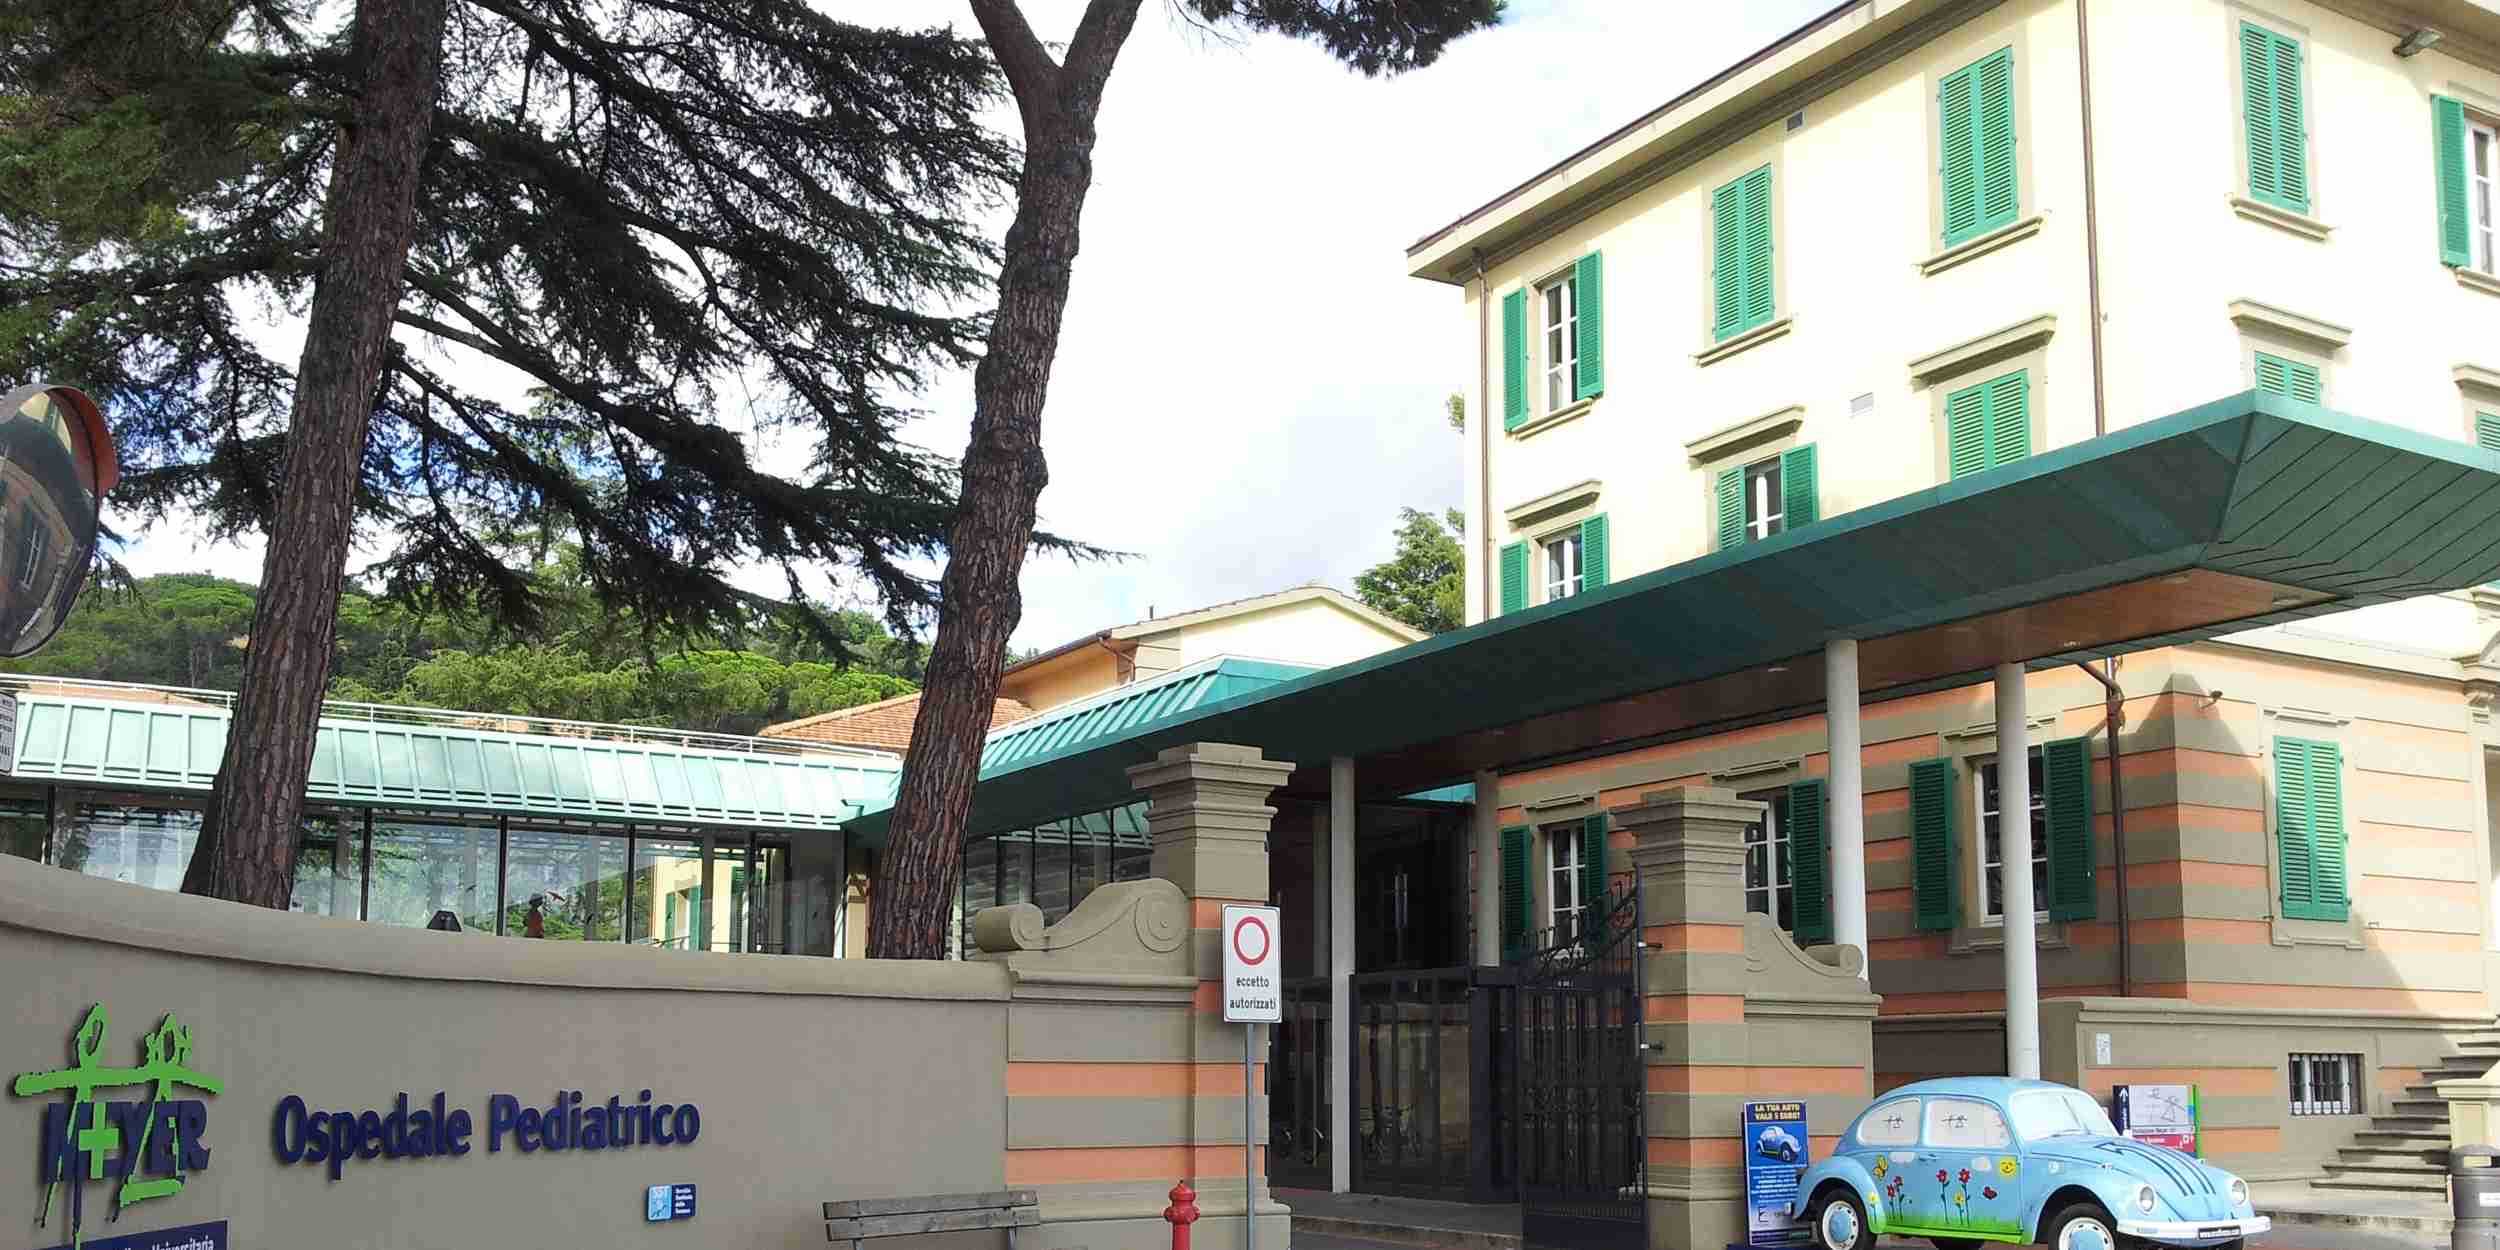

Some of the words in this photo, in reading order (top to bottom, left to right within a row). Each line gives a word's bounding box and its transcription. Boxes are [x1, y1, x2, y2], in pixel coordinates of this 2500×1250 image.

[1236, 976, 1270, 988] eccetto
[1230, 997, 1276, 1010] autorizzati
[275, 1091, 472, 1181] Ospedale
[489, 1089, 700, 1153] Pediatrico
